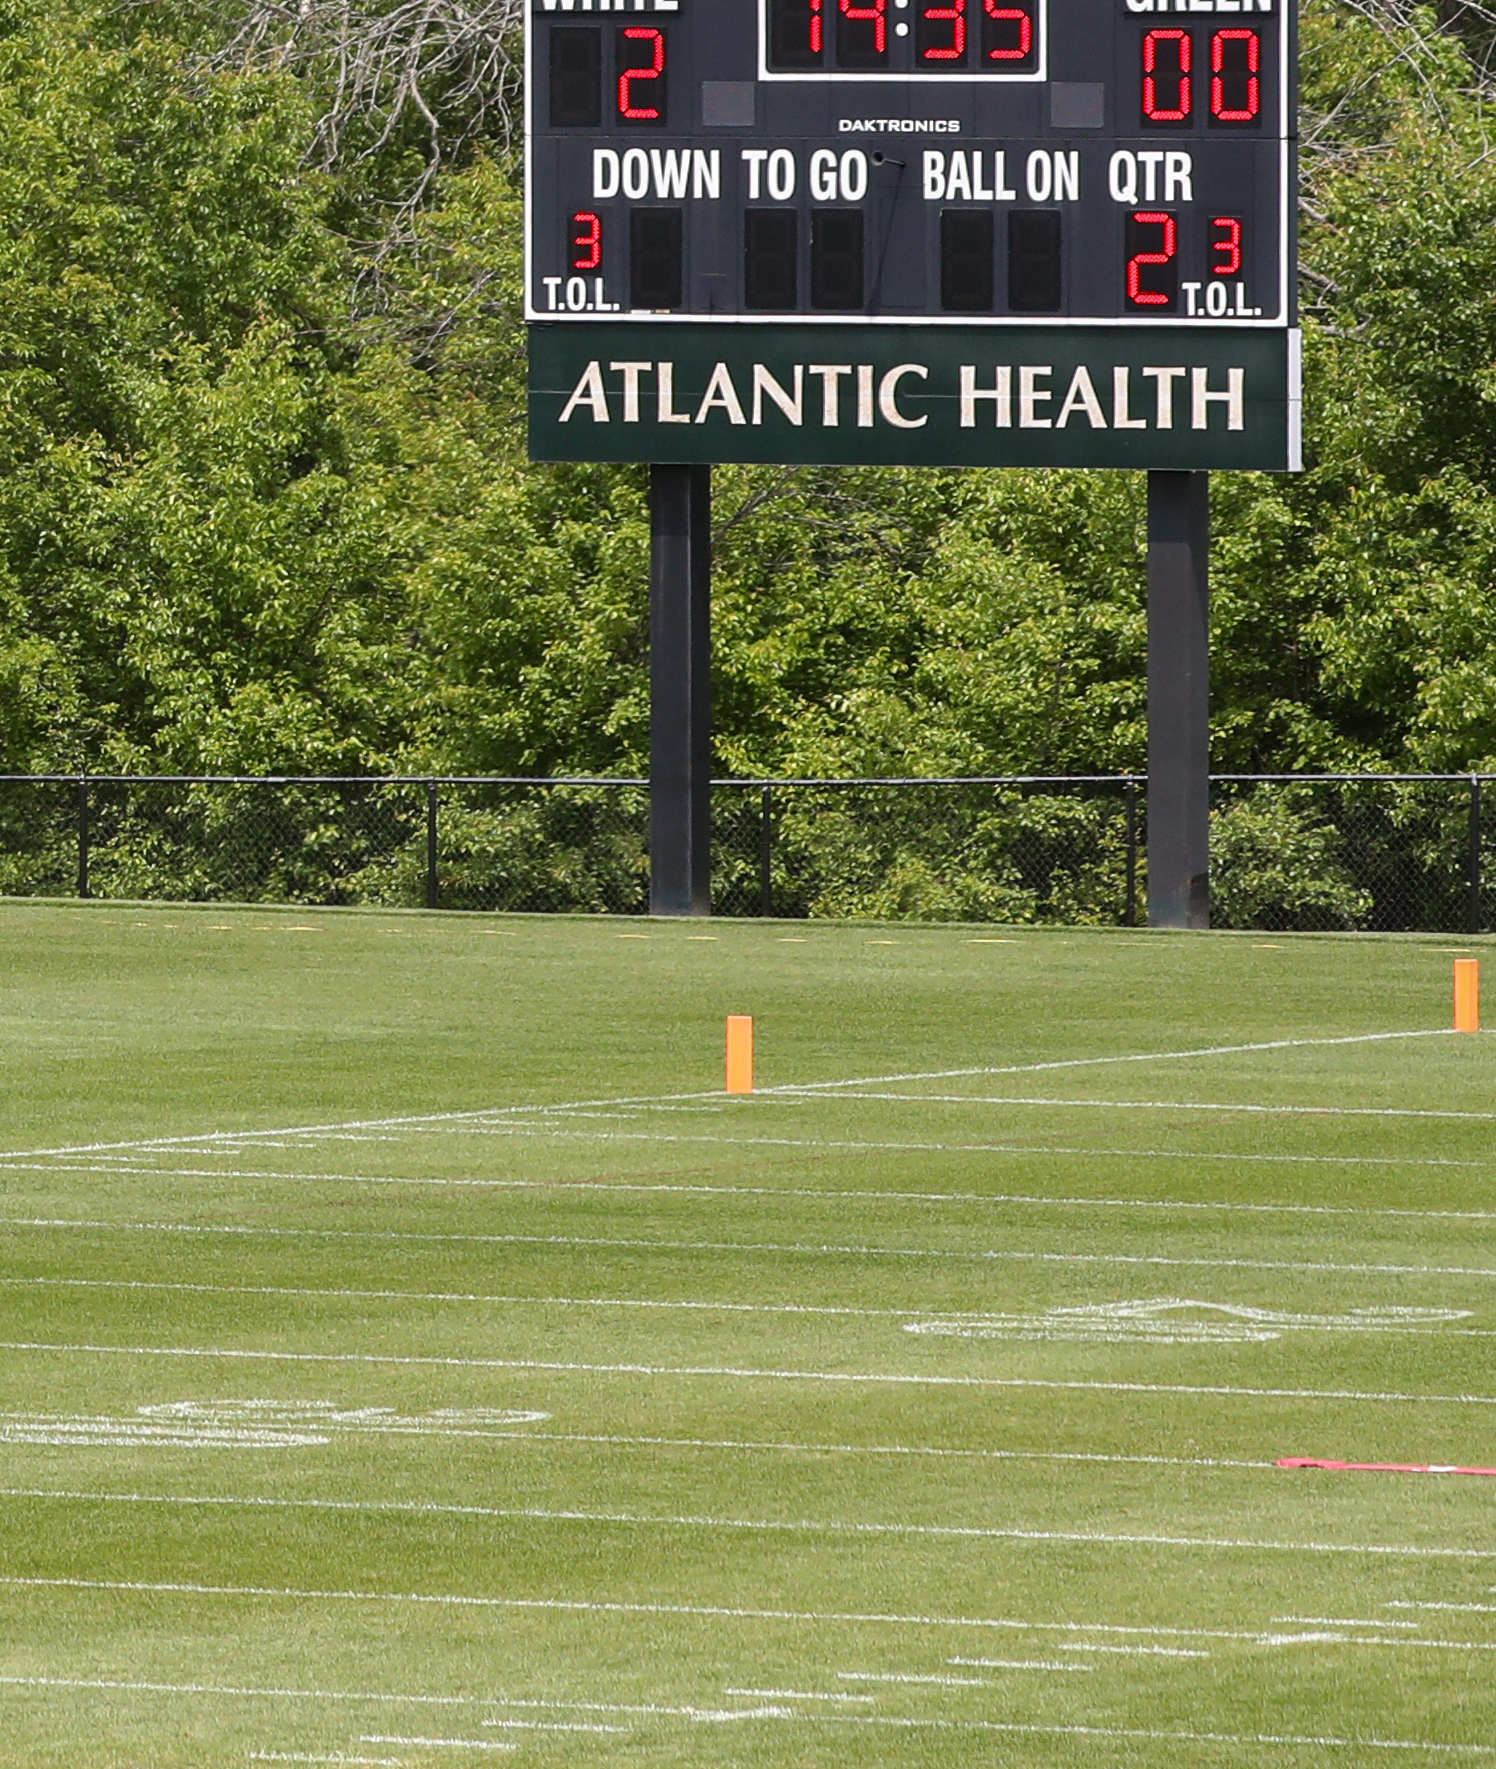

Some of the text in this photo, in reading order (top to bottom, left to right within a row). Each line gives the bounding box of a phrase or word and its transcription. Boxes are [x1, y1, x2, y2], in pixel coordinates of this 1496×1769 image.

[618, 27, 666, 120] 2
[1142, 28, 1262, 123] 00
[839, 120, 961, 134] DAKTRONICS
[594, 149, 721, 200] DOWN
[742, 150, 868, 202] TO GO
[924, 150, 1080, 202] BALL ON
[1109, 151, 1194, 205] QTR
[574, 212, 603, 270] 3
[1127, 212, 1178, 305] 2
[1213, 217, 1244, 275] 3
[543, 277, 621, 311] T.O.L.
[1182, 282, 1263, 316] T.O.L.
[558, 361, 1246, 432] ATLANTIC HEALTH
